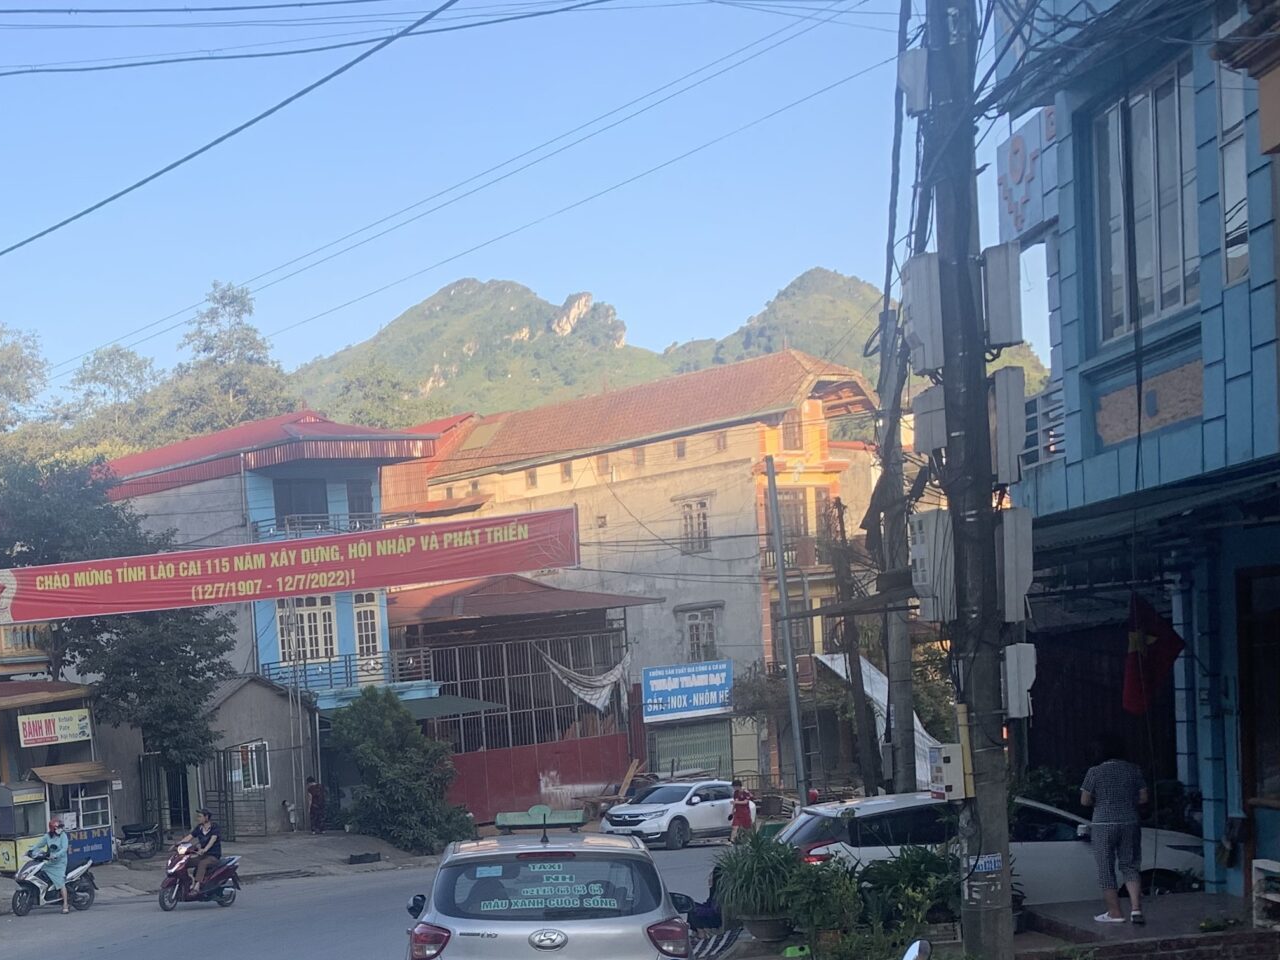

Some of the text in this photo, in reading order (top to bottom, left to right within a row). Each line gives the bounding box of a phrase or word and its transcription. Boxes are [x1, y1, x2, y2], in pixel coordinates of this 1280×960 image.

[36, 571, 70, 591] CHÀO
[74, 567, 112, 588] MỪNG
[117, 562, 146, 583] TỈNH
[150, 560, 175, 580] LÀO
[179, 563, 202, 577] CAI
[206, 558, 230, 574] 115
[233, 552, 266, 572] NĂM
[270, 548, 297, 568] XÂY
[348, 539, 372, 562] HỘI
[376, 534, 416, 557] NHẬP
[420, 531, 439, 551] VÀ
[443, 527, 481, 548] PHÁT
[485, 518, 529, 544] TRIỂN
[191, 579, 262, 602] (12/7/1907
[276, 568, 356, 592] 12/7/2022)!
[667, 694, 688, 710] INOX
[692, 688, 718, 706] NHÔM
[22, 716, 44, 738] BÁNH
[528, 863, 563, 872] TAXI
[511, 899, 545, 910] XANH
[583, 895, 618, 909] SỐNG
